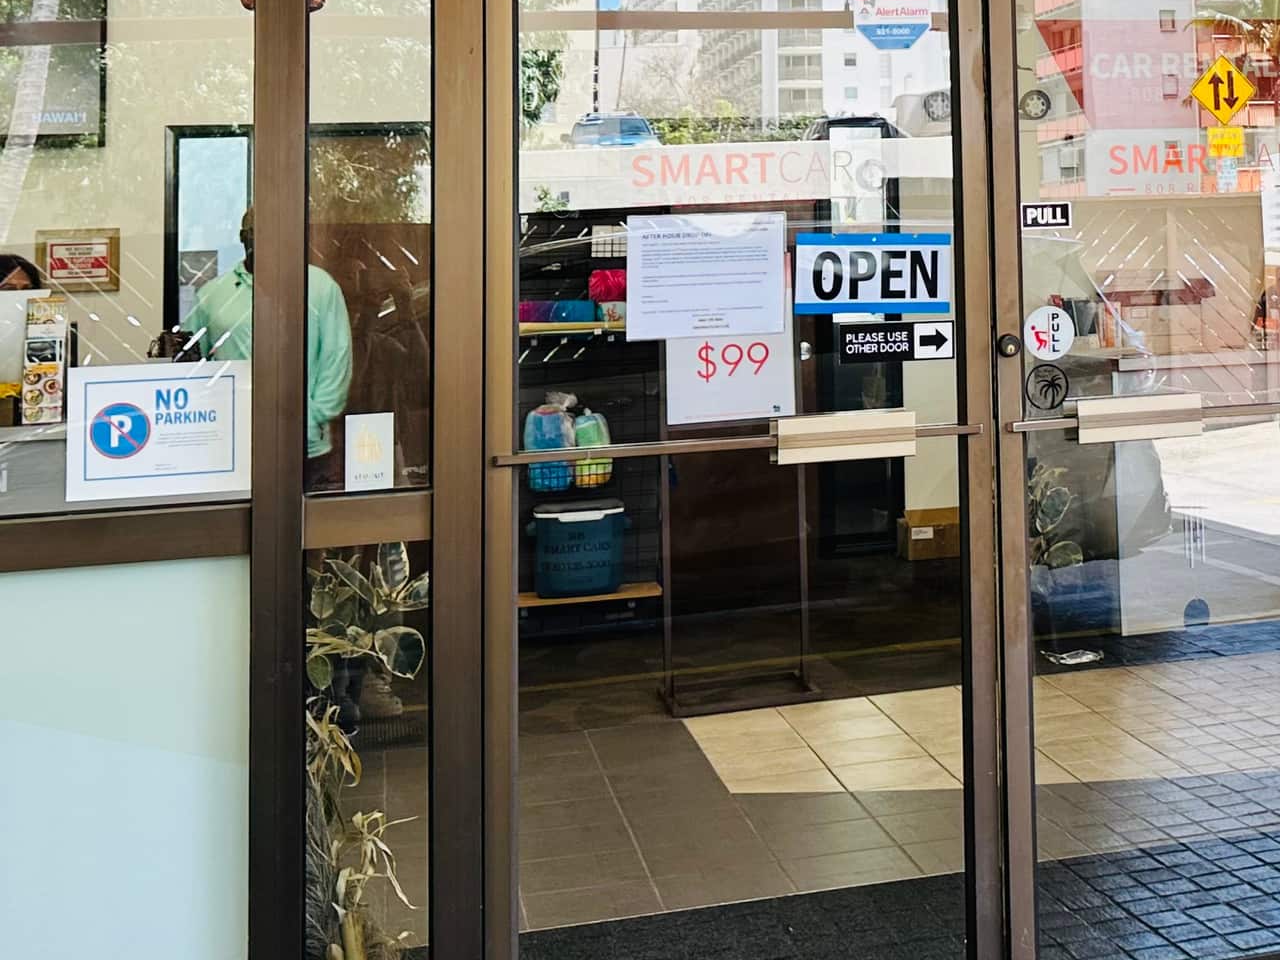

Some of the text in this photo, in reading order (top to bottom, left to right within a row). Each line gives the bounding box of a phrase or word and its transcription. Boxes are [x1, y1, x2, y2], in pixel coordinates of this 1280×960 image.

[875, 6, 929, 17] AlertAlarm
[1026, 207, 1066, 225] PULL
[812, 250, 938, 300] OPEN
[846, 332, 908, 343] PLEASE USE
[845, 342, 909, 355] OTHER DOOR
[696, 341, 770, 383] $99
[155, 387, 189, 411] NO
[155, 409, 217, 425] PARKING
